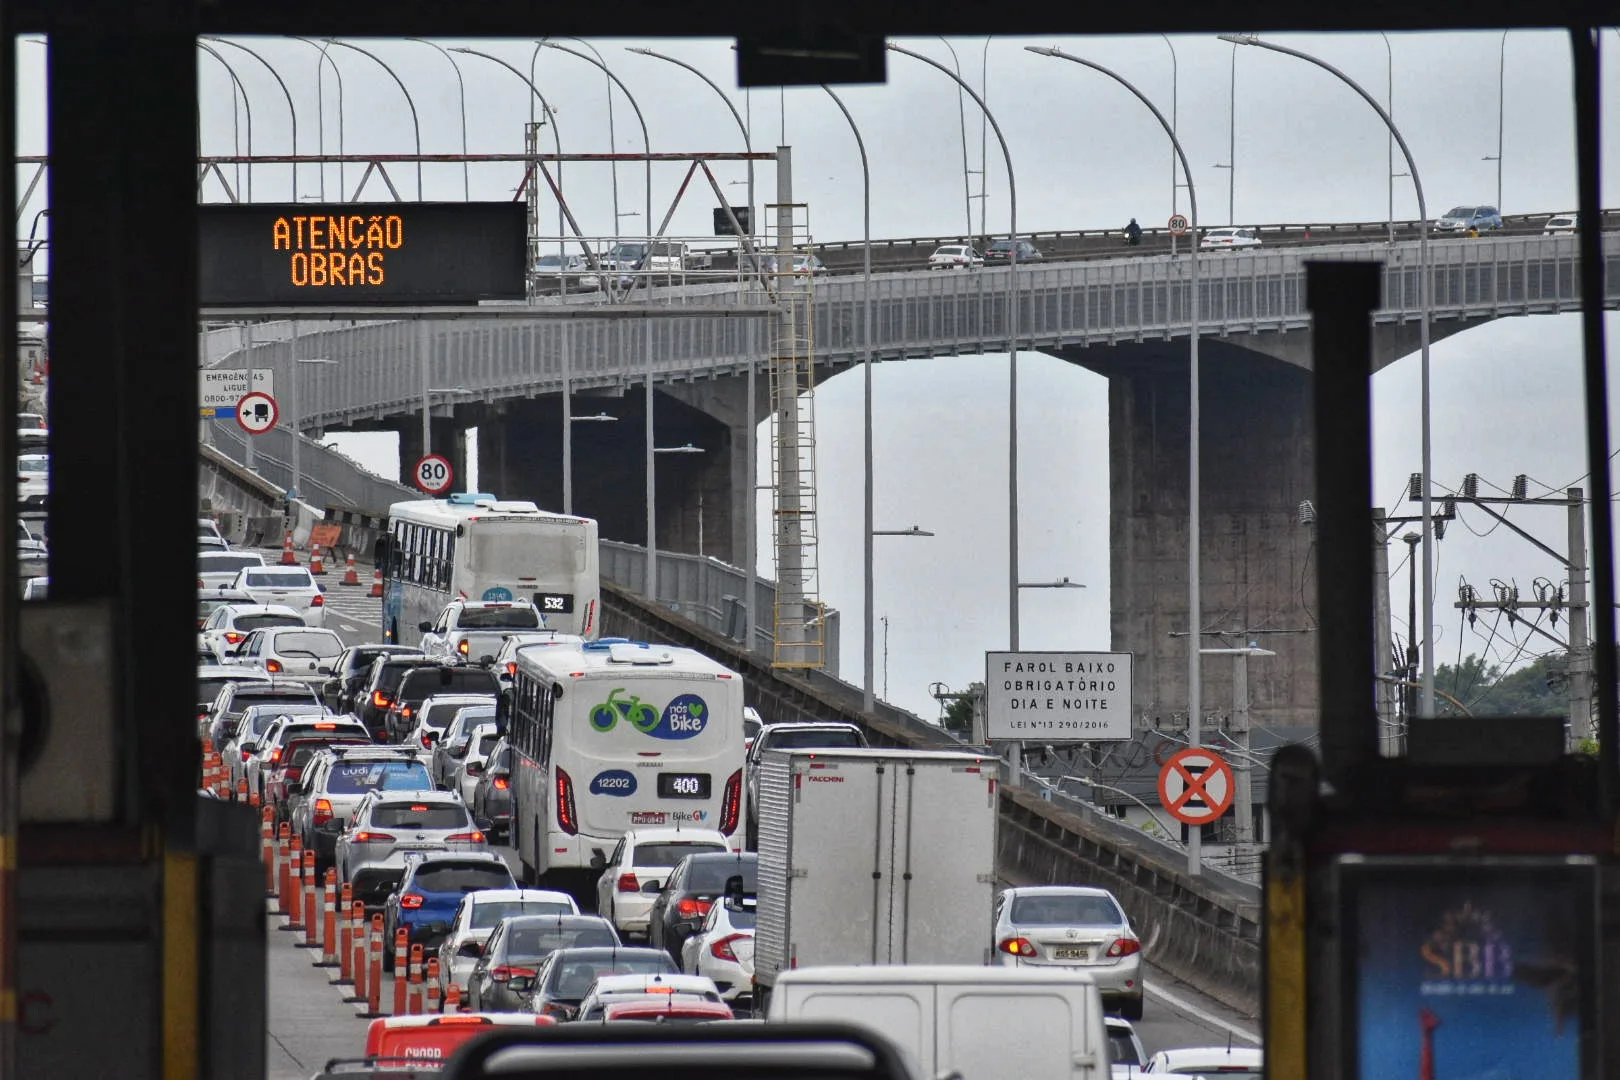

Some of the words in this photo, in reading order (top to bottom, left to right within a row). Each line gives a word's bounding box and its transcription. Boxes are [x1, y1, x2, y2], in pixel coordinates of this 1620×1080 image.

[1171, 219, 1185, 228] 80
[273, 215, 402, 249] ATENÇÃO
[291, 252, 384, 286] OBRAS
[206, 371, 264, 381] EMERGÊNCAS
[223, 384, 247, 392] LIGUE
[421, 463, 446, 480] 80
[544, 597, 564, 610] 532
[1004, 662, 1056, 673] FAROL
[1065, 662, 1115, 673] BAIXO
[1004, 677, 1116, 691] OBRIGATÓRIO
[670, 702, 688, 713] nós
[1011, 699, 1038, 709] DIA
[1047, 699, 1054, 709] E
[1062, 699, 1108, 709] NOITE
[671, 714, 702, 731] Bike
[1010, 721, 1027, 729] LEI
[598, 778, 630, 788] 12202
[673, 777, 699, 793] 400
